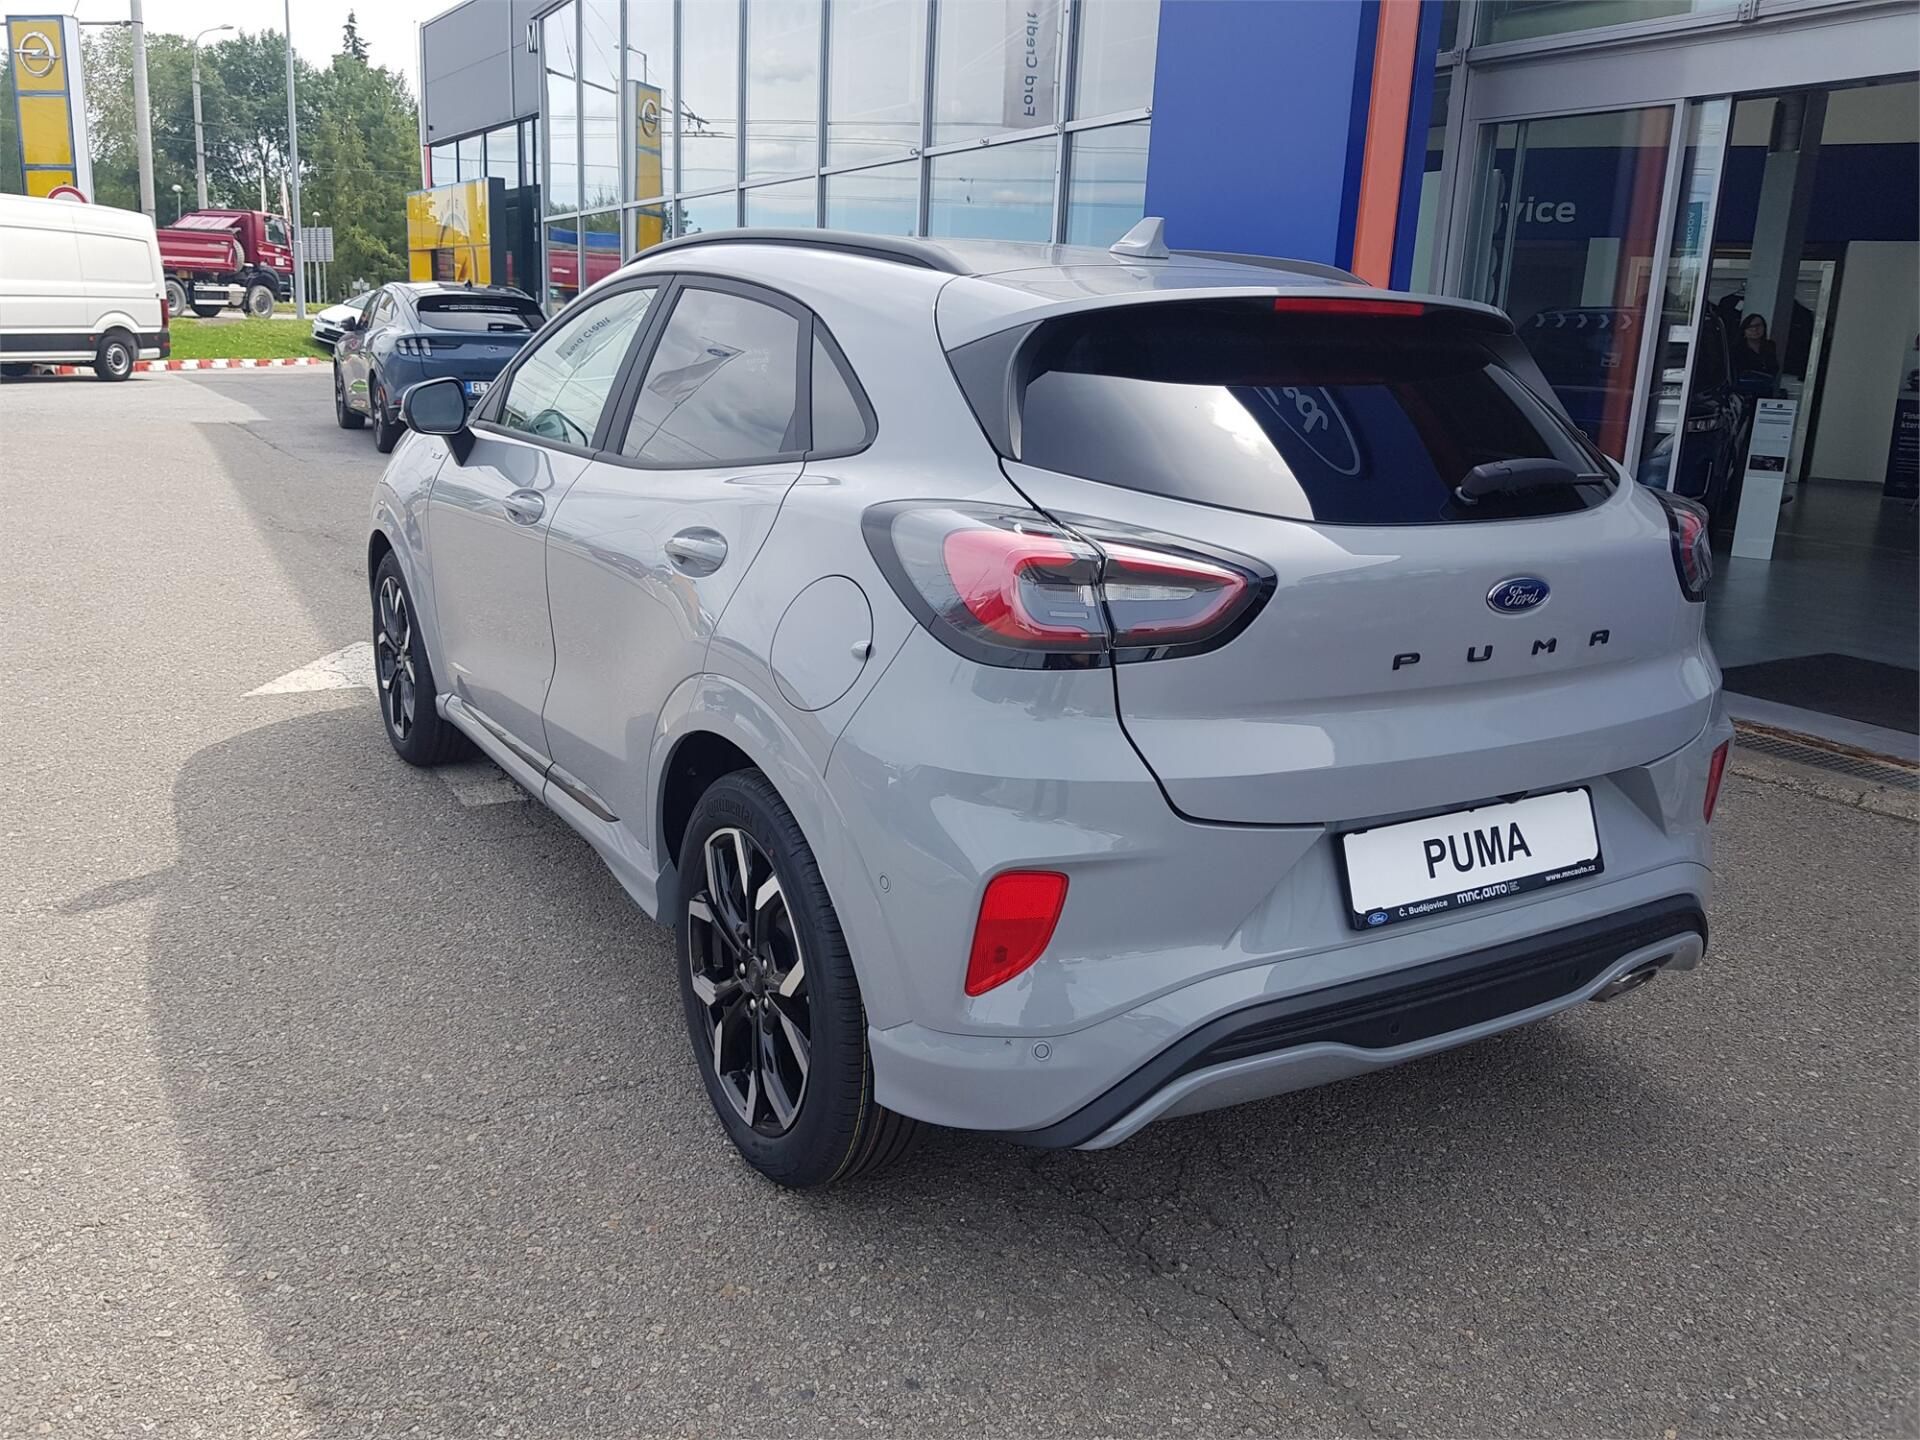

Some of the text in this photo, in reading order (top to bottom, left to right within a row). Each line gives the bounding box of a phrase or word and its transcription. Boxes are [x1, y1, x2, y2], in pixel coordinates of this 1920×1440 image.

[1505, 584, 1539, 607] Ford
[1392, 629, 1610, 671] PUMA
[1423, 822, 1532, 879] PUMA
